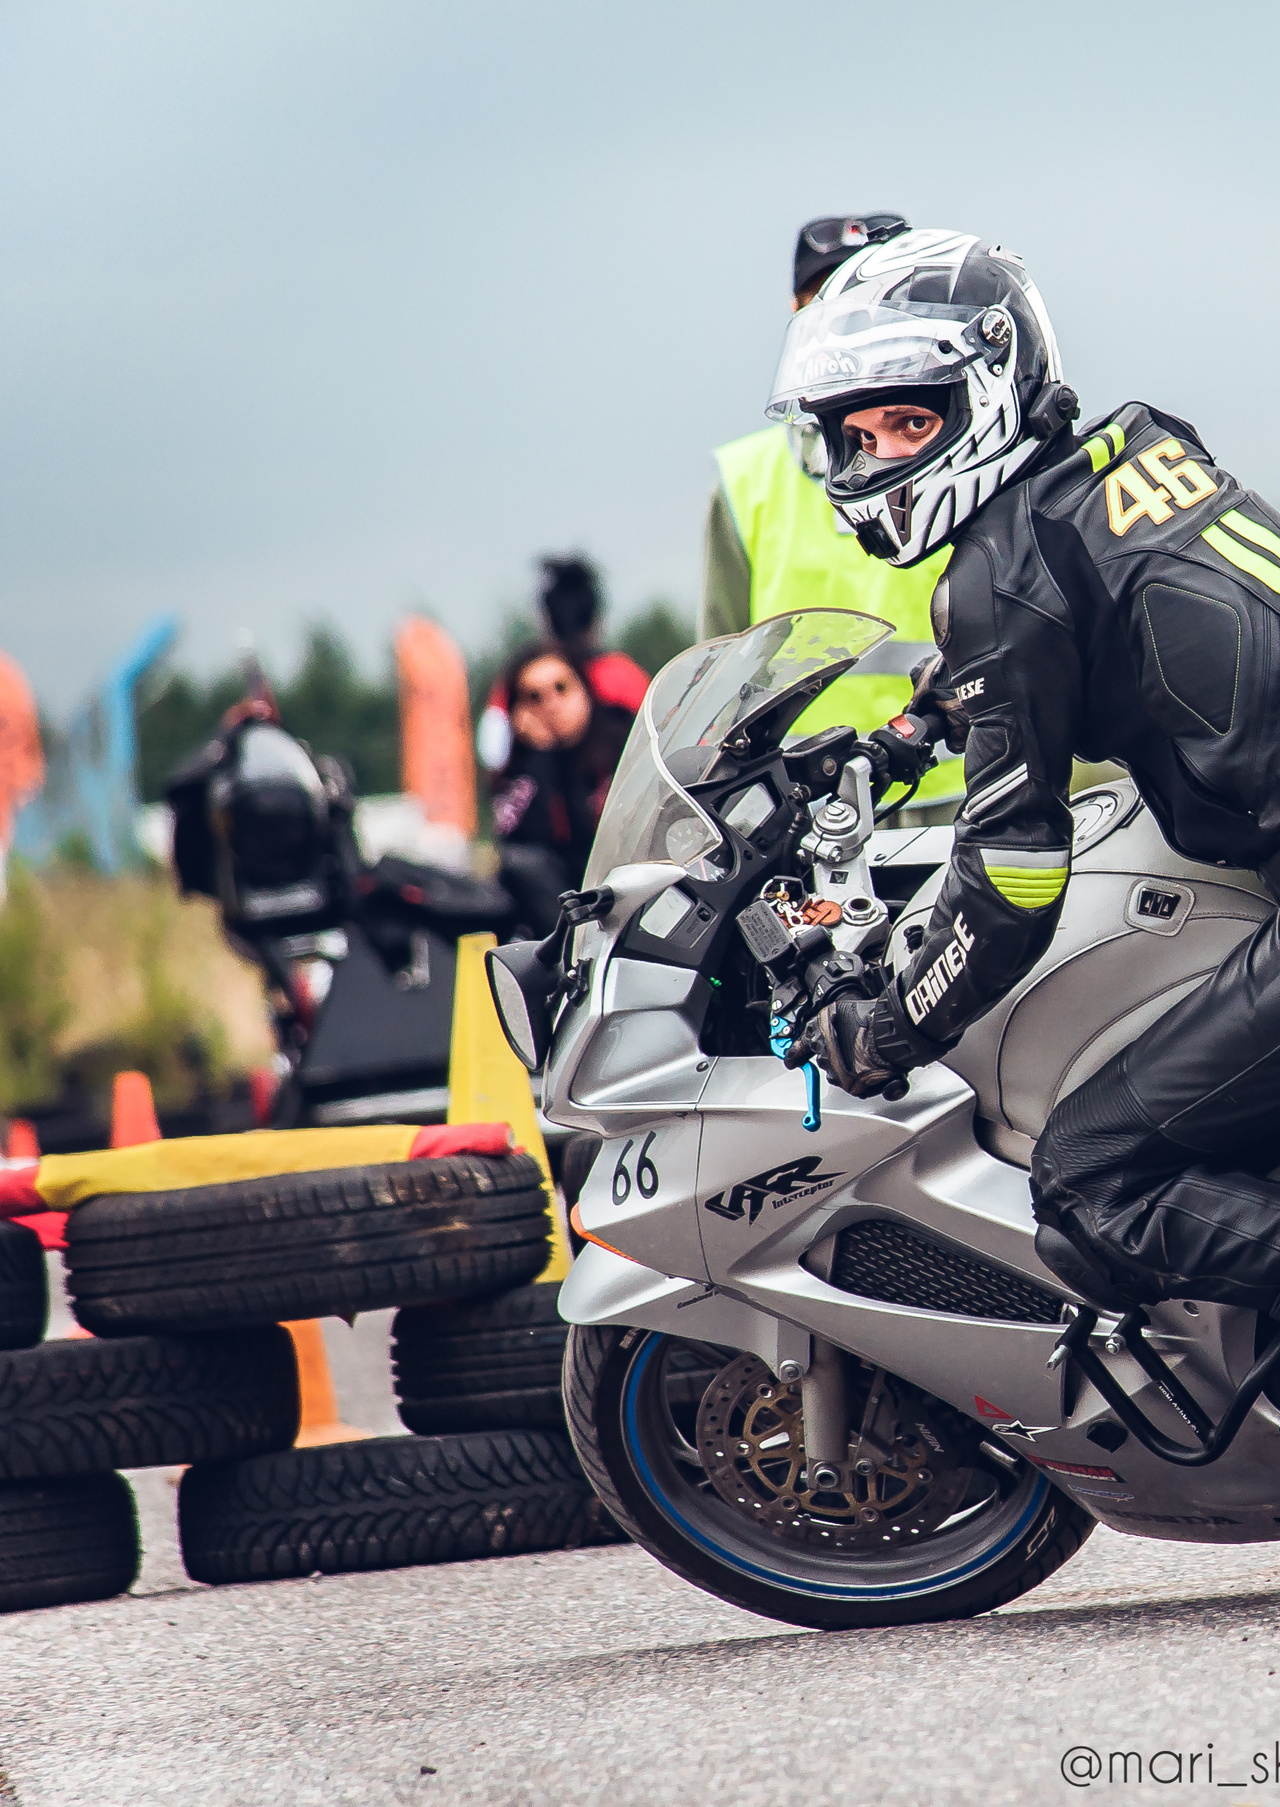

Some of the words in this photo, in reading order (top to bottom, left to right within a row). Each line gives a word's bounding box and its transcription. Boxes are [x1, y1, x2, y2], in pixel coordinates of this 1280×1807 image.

[1105, 438, 1218, 537] 46
[612, 1131, 660, 1206] 66
[771, 1179, 836, 1210] Interceptor
